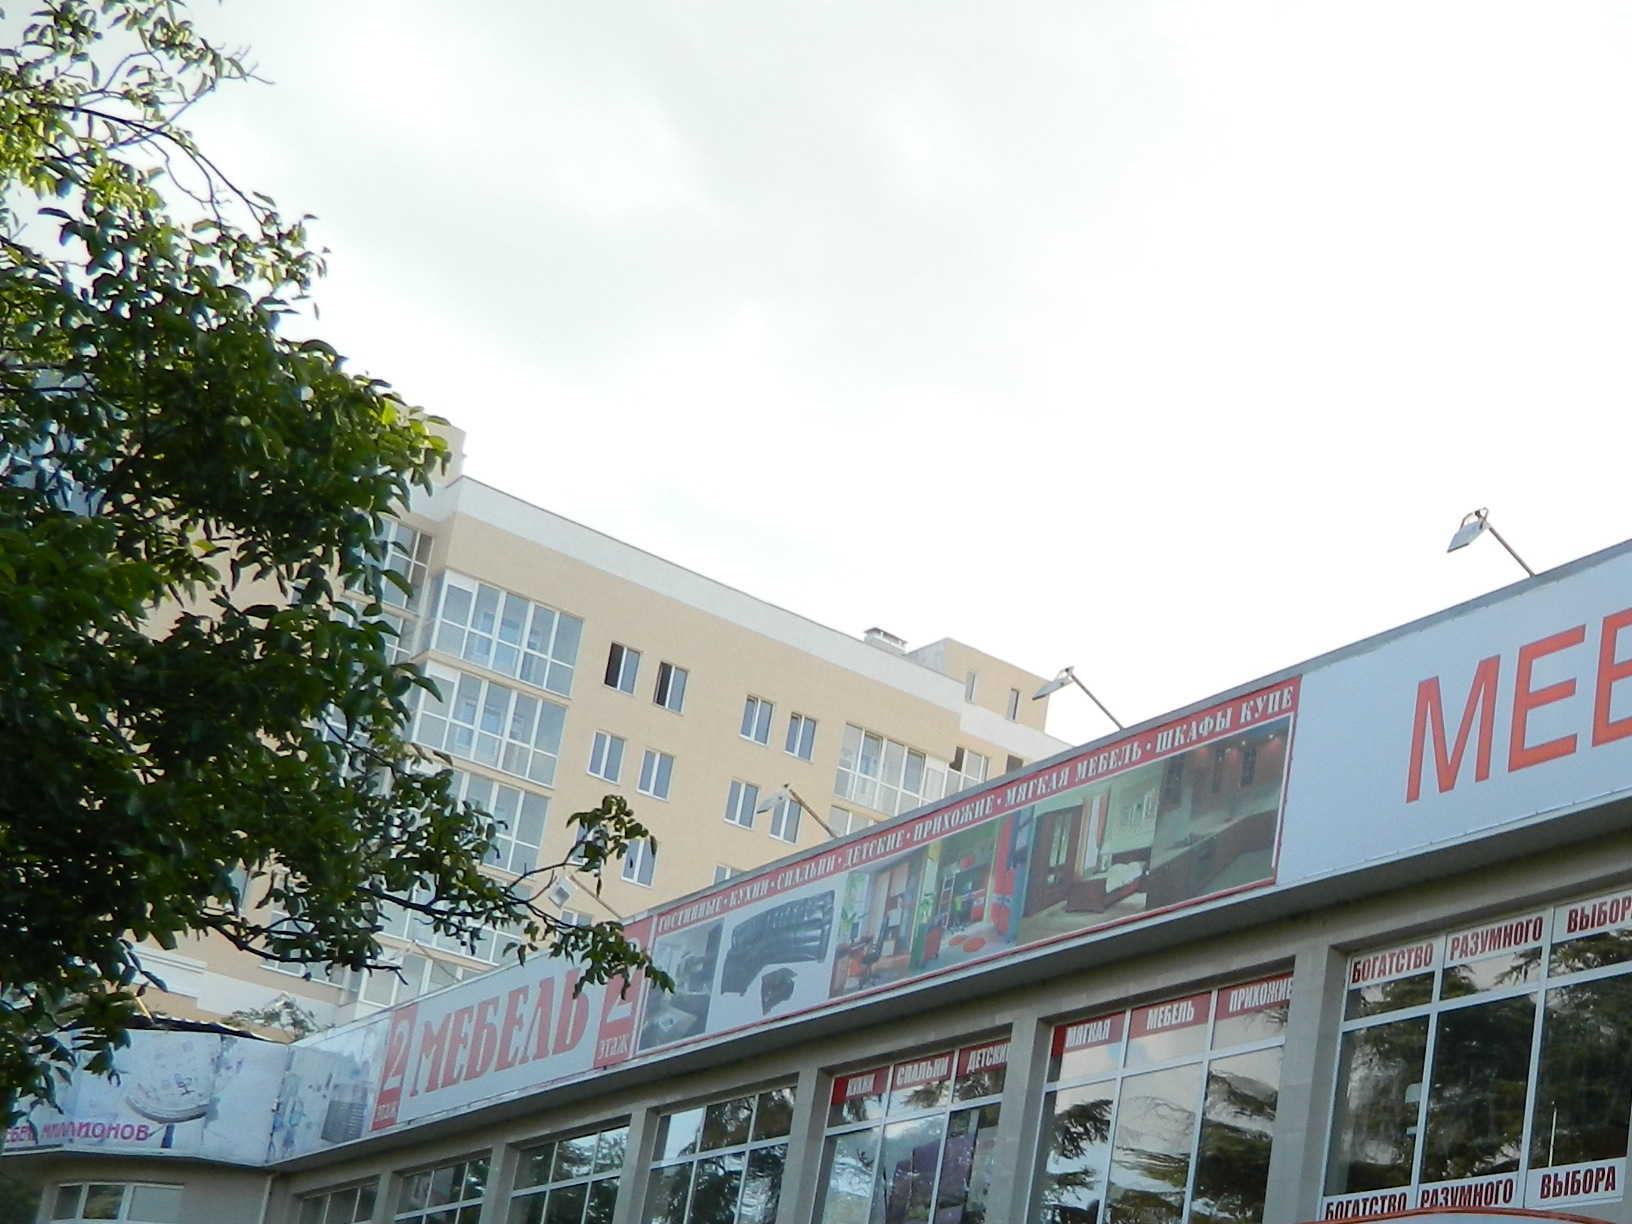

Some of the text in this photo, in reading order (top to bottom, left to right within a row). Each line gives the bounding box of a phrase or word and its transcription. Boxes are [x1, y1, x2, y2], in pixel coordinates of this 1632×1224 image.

[657, 685, 1294, 932] ГОСТИННЫЕ КУХНИ СПАЛЬНИ ДЕТСКИЕ ПРИХОЖИЕ МЯГКАЯ МЕБЕЛЬ ШКАФЫ КУПЕ
[1351, 942, 1435, 984] БОГАТСТВО
[1449, 916, 1545, 961] РАЗУМНОГО
[1228, 976, 1293, 1013] ПРИХОЖИЕ
[383, 1018, 410, 1091] 2
[408, 967, 589, 1098] МЕБЕЛЬ
[1065, 1001, 1196, 1048] МЯГКАЯ МЕБЕЛЬ
[846, 1073, 875, 1097] КУХНИ
[896, 1056, 950, 1086] СПАЛЬНИ
[1325, 1164, 1617, 1221] БОГАТСТВО РАЗУМНОГО ВЫБОРА
